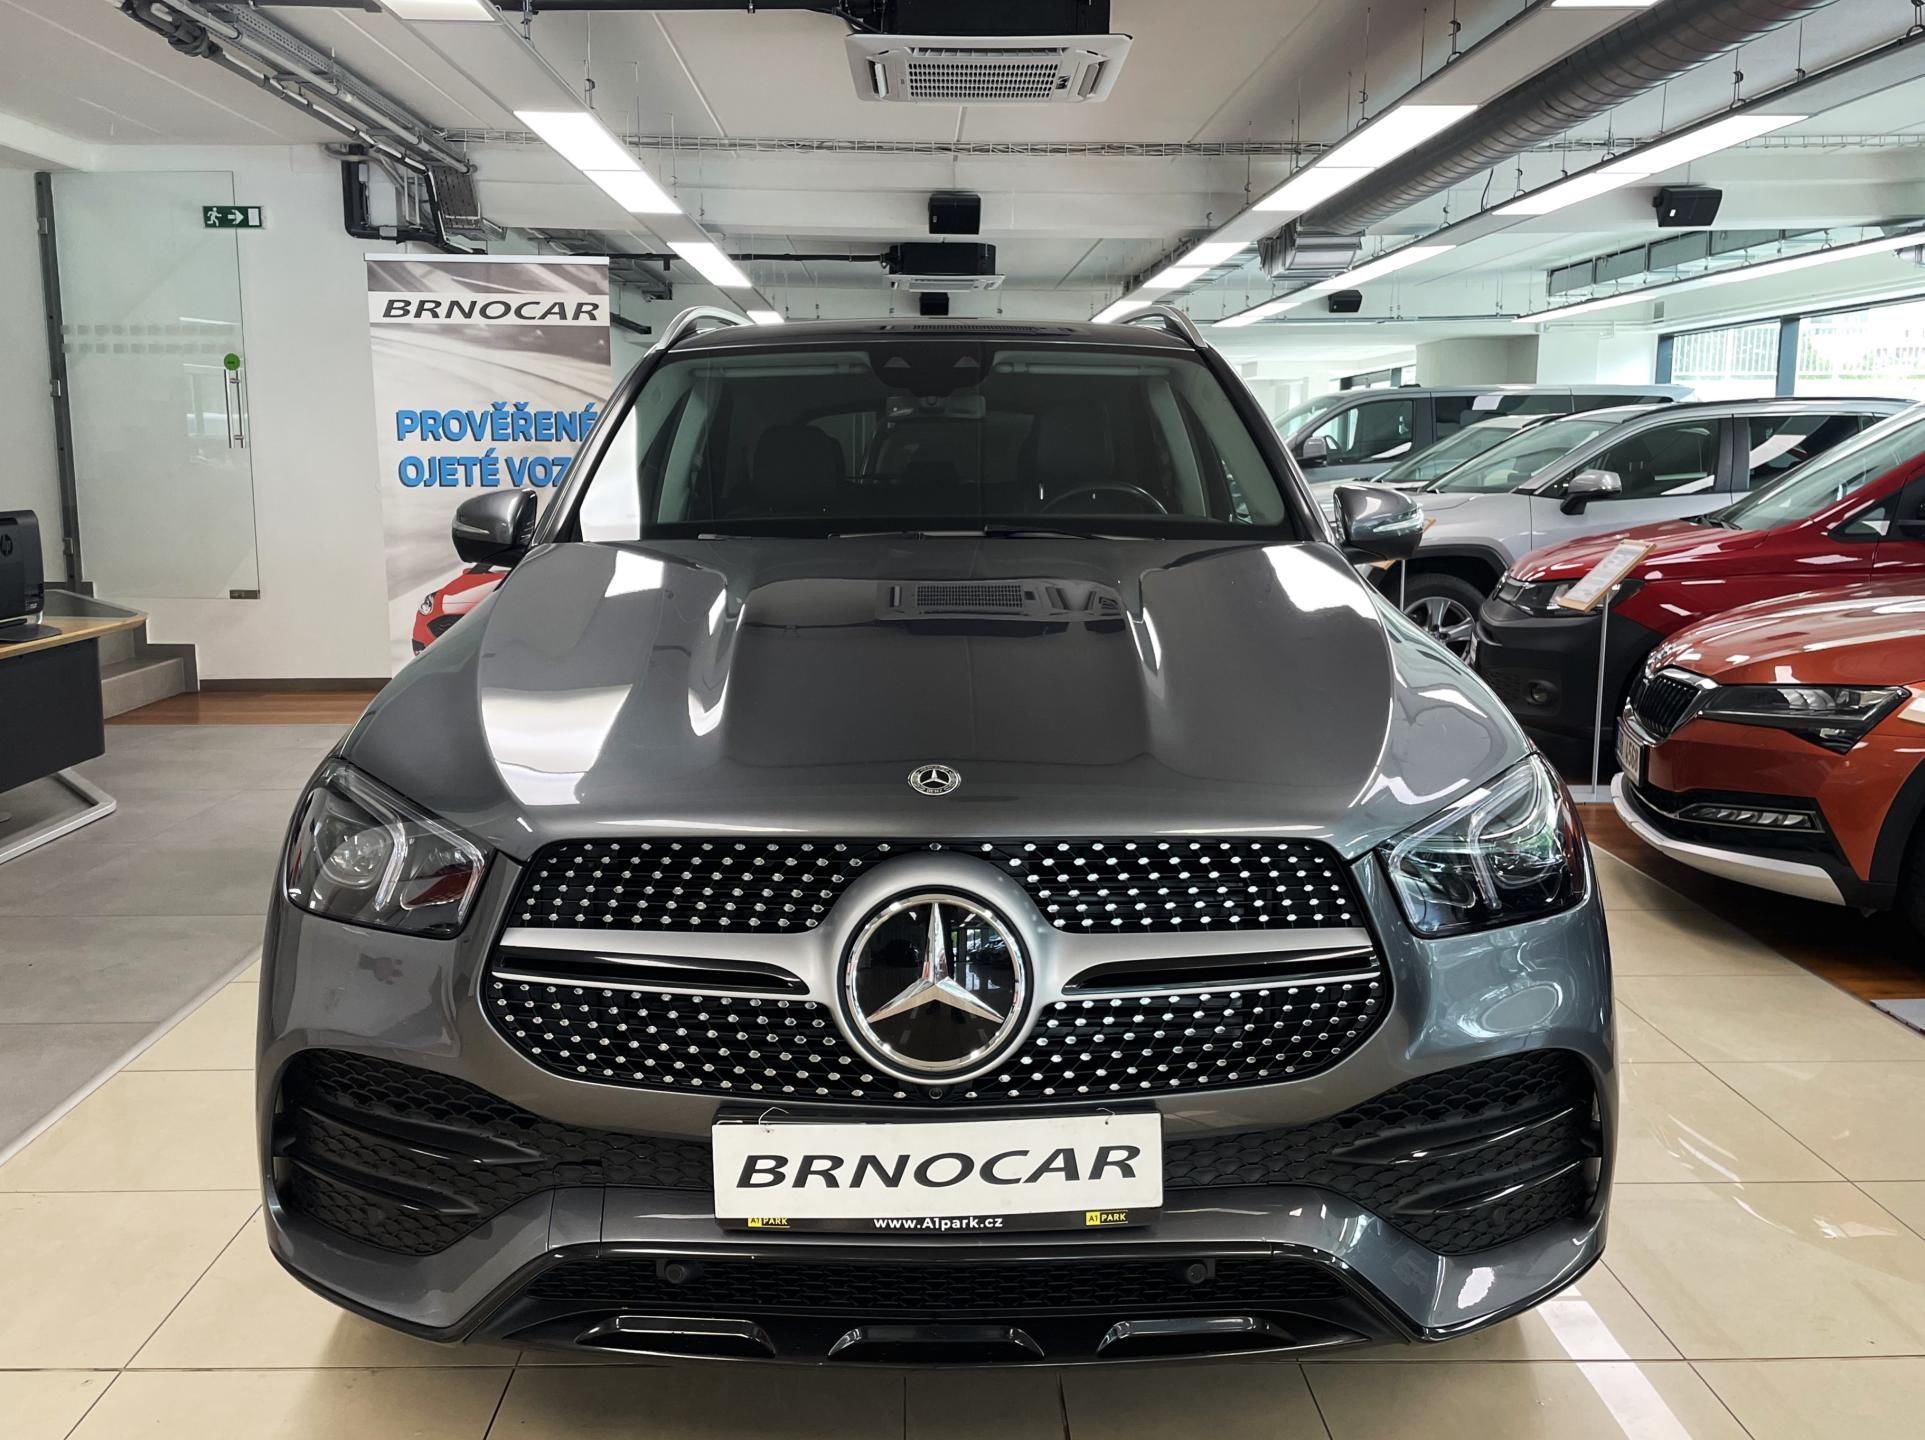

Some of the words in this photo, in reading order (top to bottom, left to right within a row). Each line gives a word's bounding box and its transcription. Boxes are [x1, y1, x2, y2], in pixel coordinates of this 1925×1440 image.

[382, 299, 600, 321] BRNOCAR
[396, 401, 598, 442] PROVĚŘENÉ
[399, 447, 500, 487] OJETÉ
[504, 456, 573, 487] VOZ
[736, 1145, 1141, 1189] BRNOCAR
[873, 1216, 1003, 1231] www.A1park.cz
